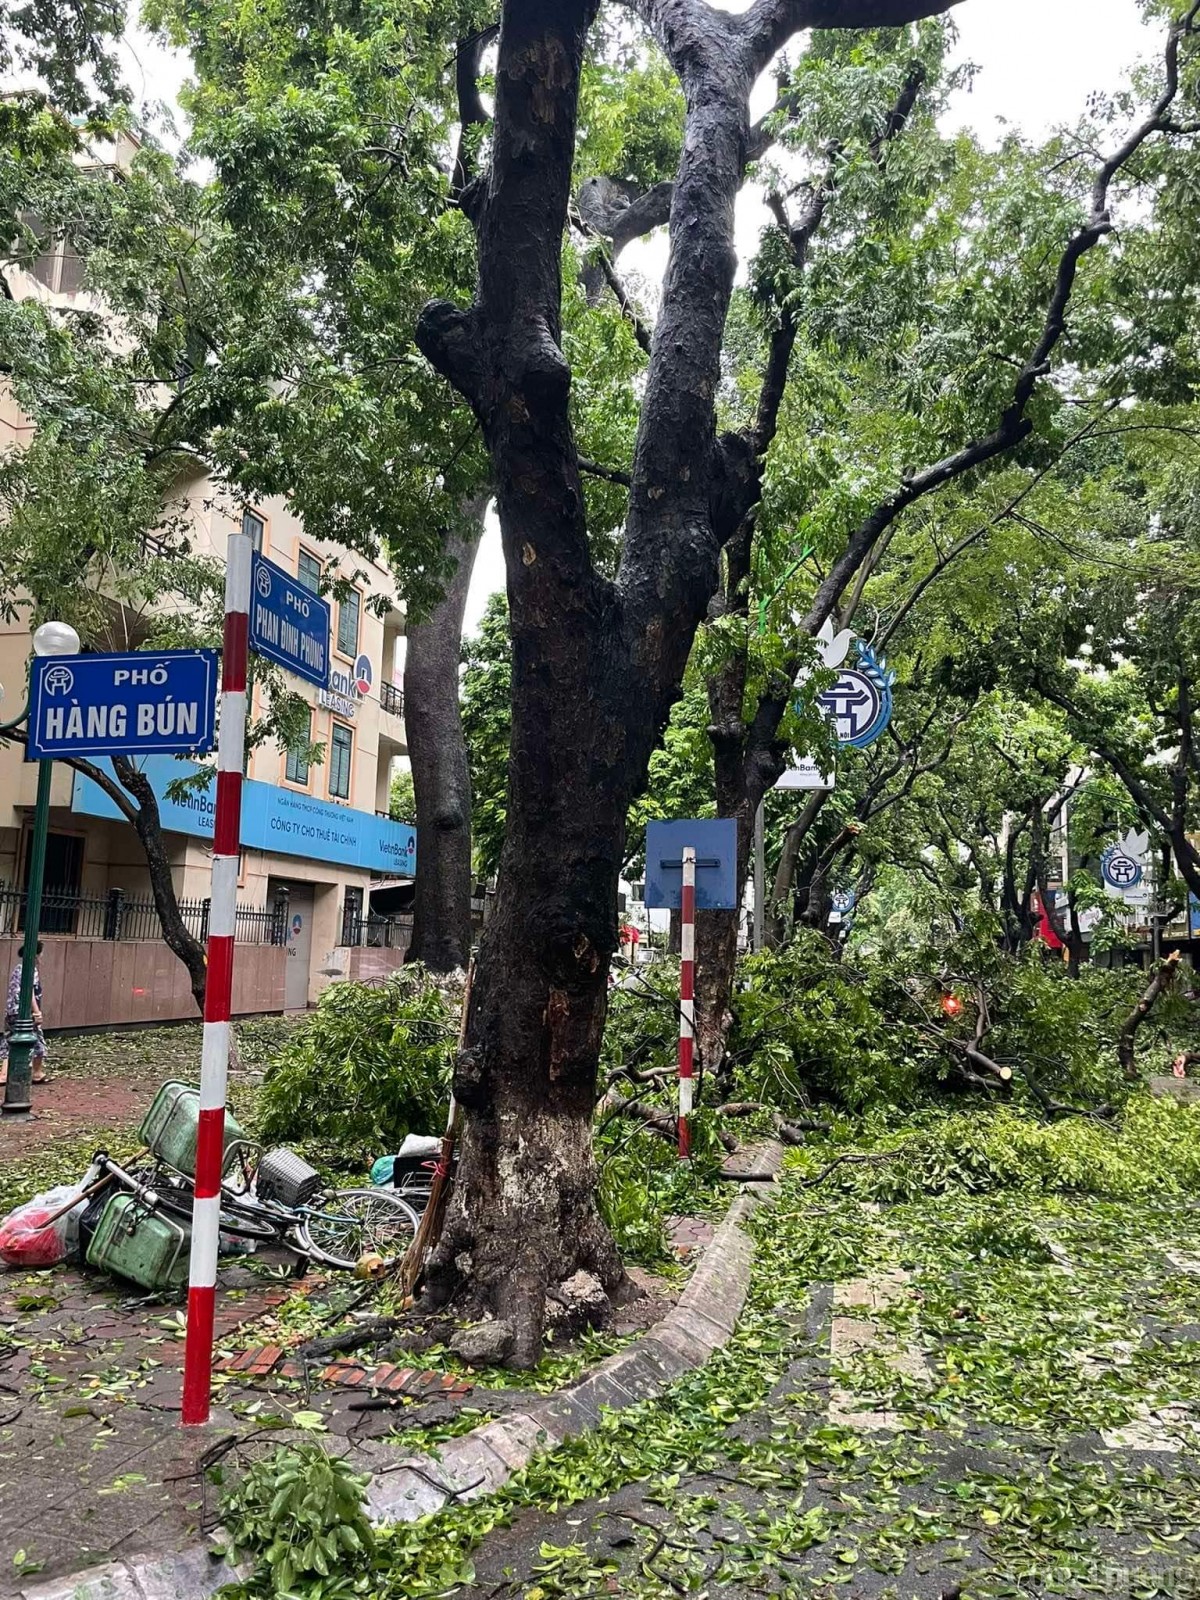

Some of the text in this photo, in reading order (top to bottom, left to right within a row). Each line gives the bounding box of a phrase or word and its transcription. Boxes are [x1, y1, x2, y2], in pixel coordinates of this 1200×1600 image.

[286, 590, 311, 618] PHỐ
[256, 603, 324, 673] PHAN ĐÌNH PHÙNG
[114, 661, 171, 686] PHỐ
[45, 695, 198, 740] HÀNG BÚN
[270, 816, 357, 847] CÔNG TY CHO THUÊ TÀI CHÍNH
